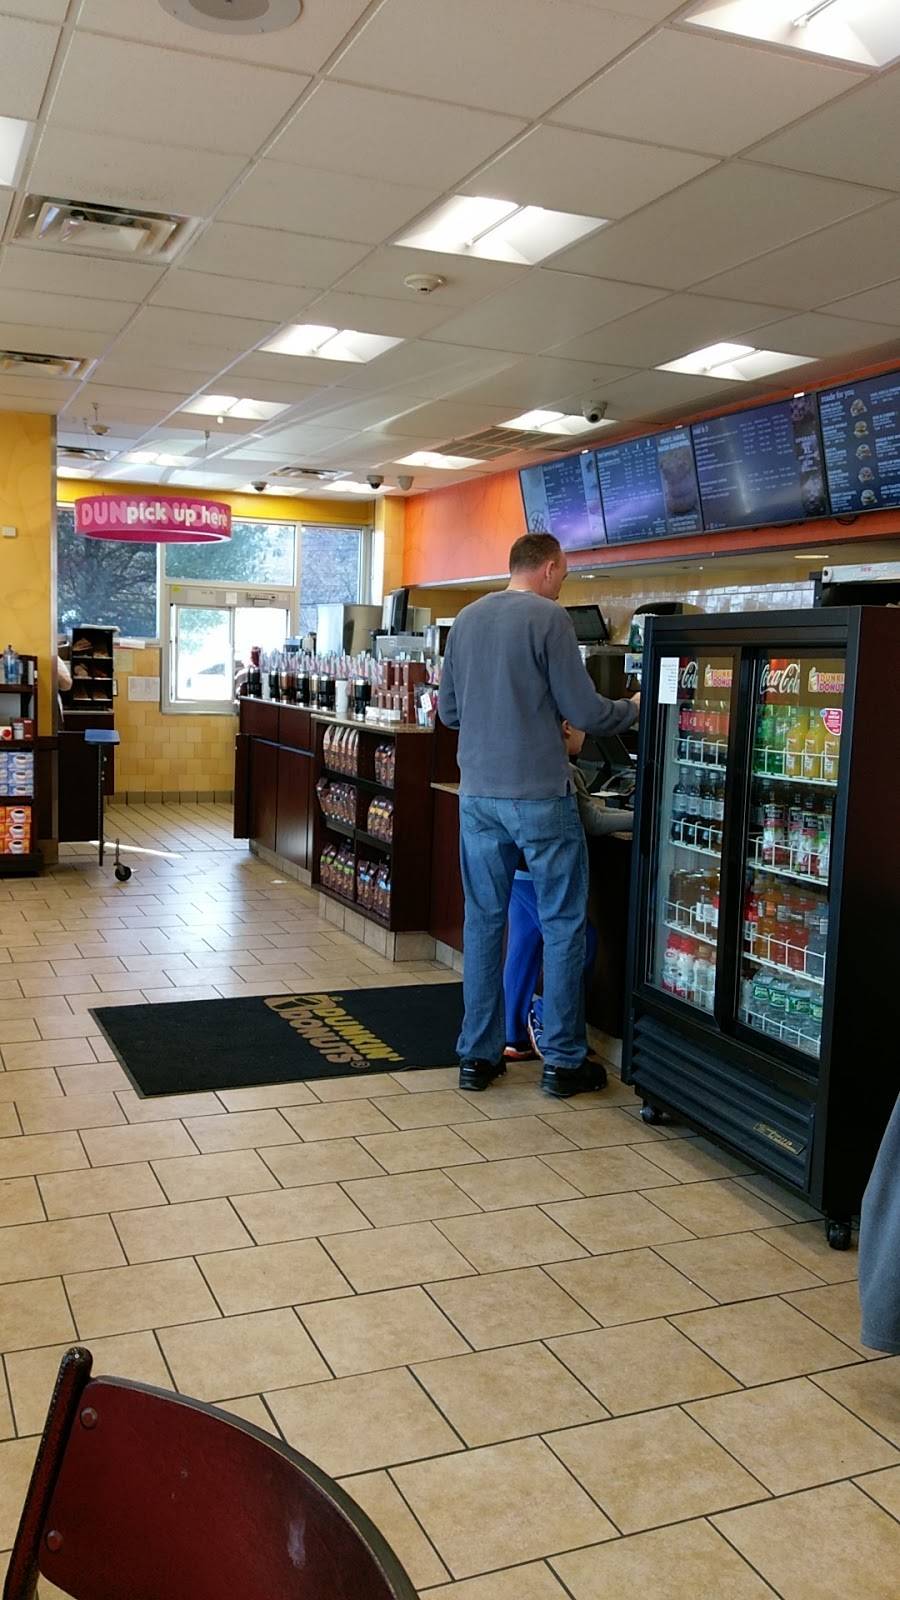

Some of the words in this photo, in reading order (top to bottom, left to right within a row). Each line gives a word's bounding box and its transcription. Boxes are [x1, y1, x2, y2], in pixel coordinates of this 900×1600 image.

[127, 502, 167, 524] pick
[173, 508, 196, 527] up
[278, 1009, 365, 1063] DONUTS
